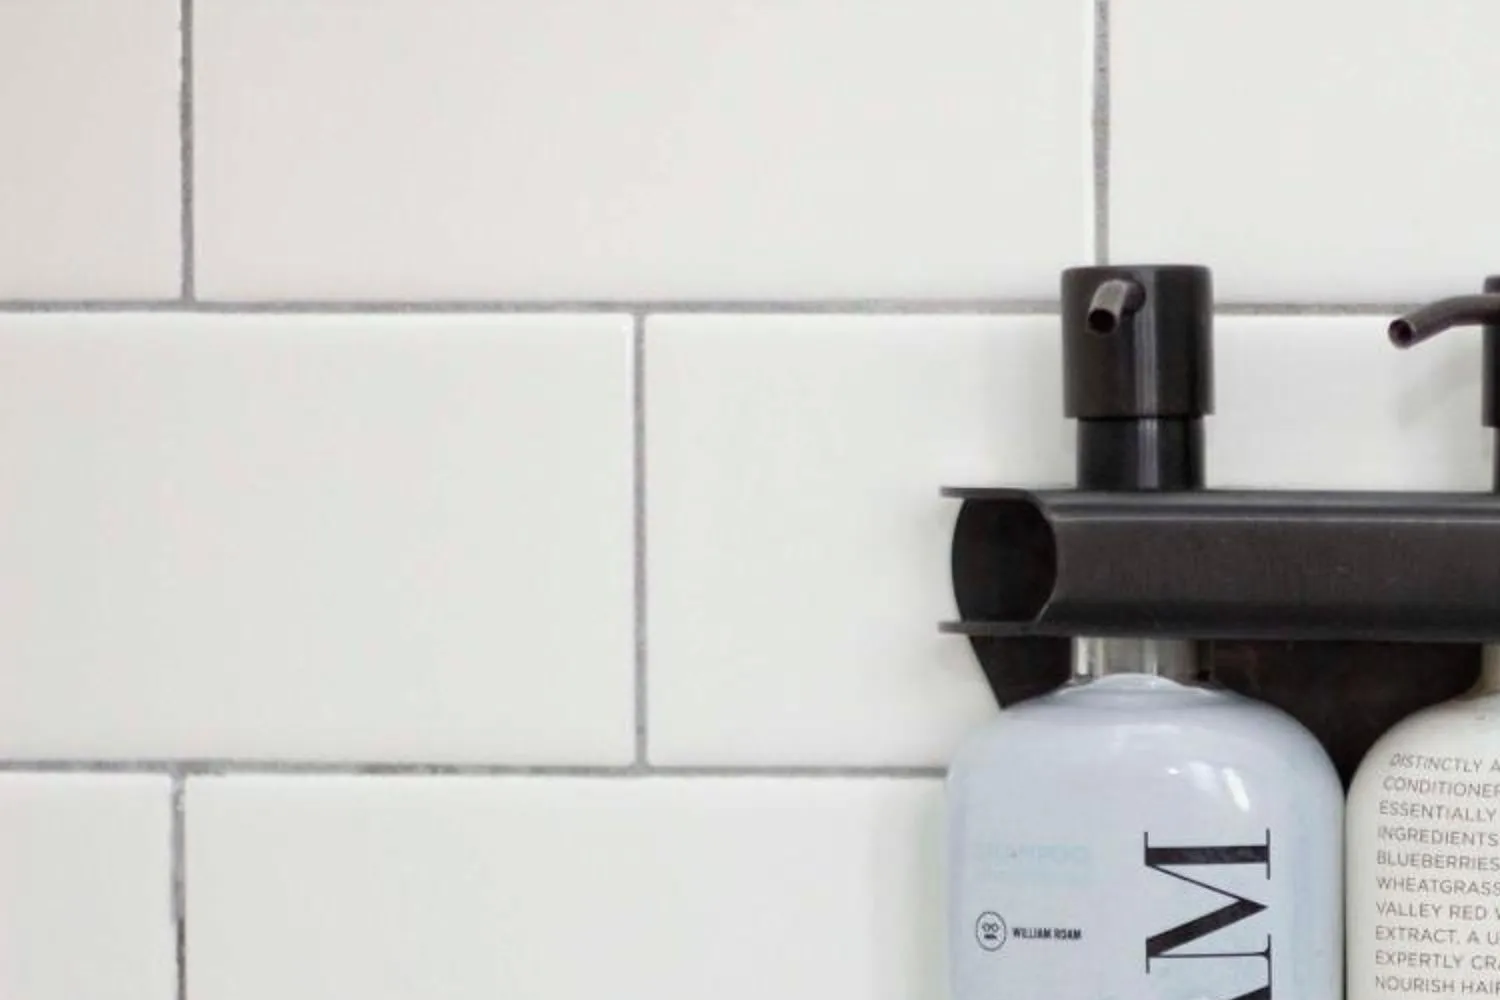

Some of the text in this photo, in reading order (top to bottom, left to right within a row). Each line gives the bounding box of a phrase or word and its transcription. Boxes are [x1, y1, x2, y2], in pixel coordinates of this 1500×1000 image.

[1389, 753, 1482, 773] DISTINCTLY
[1379, 801, 1496, 822] ESSENTIALLY
[1377, 826, 1499, 847] INGREDIENTS
[1375, 901, 1441, 919] VALLEY
[1450, 905, 1487, 921] RED
[1012, 926, 1053, 941] WILLIAM
[1467, 931, 1480, 946] A
[1375, 950, 1464, 971] EXPERTLY
[1375, 975, 1455, 994] NOURISH
